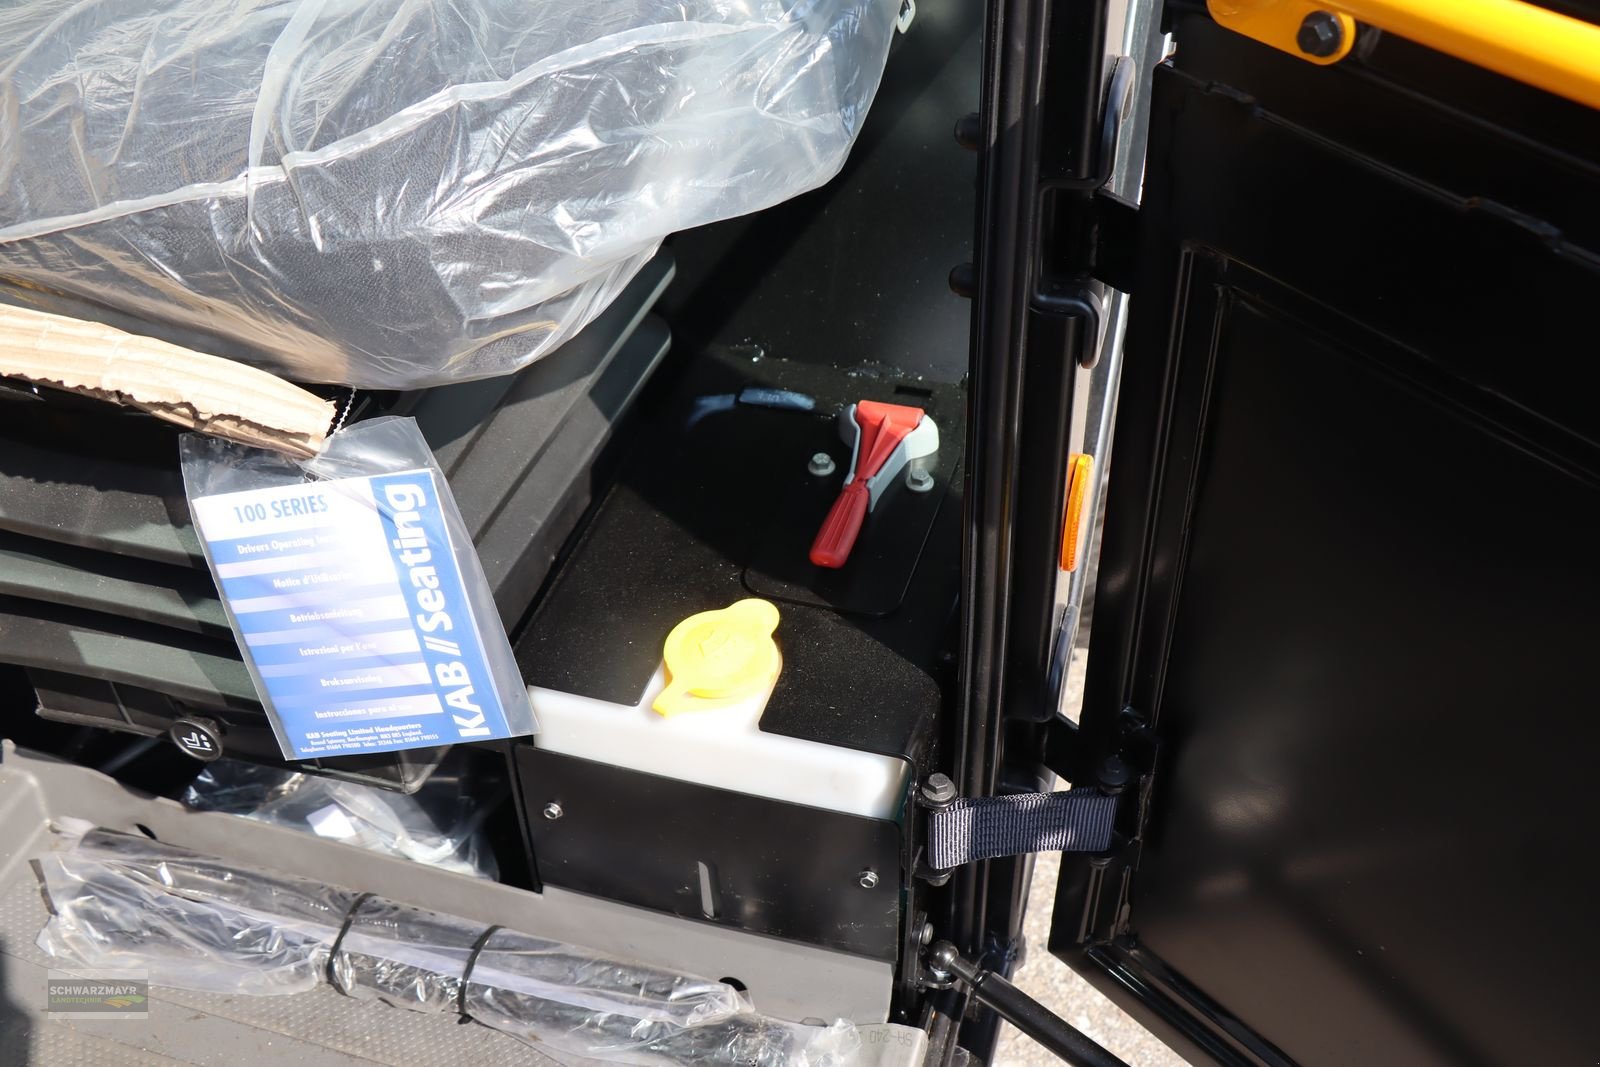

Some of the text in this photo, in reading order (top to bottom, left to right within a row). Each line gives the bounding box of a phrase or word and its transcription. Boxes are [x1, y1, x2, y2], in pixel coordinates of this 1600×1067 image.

[233, 494, 329, 524] 100 SERIES
[237, 542, 270, 555] Drivers
[271, 537, 315, 552] Operating
[384, 483, 454, 633] Seating
[435, 661, 491, 738] KAB
